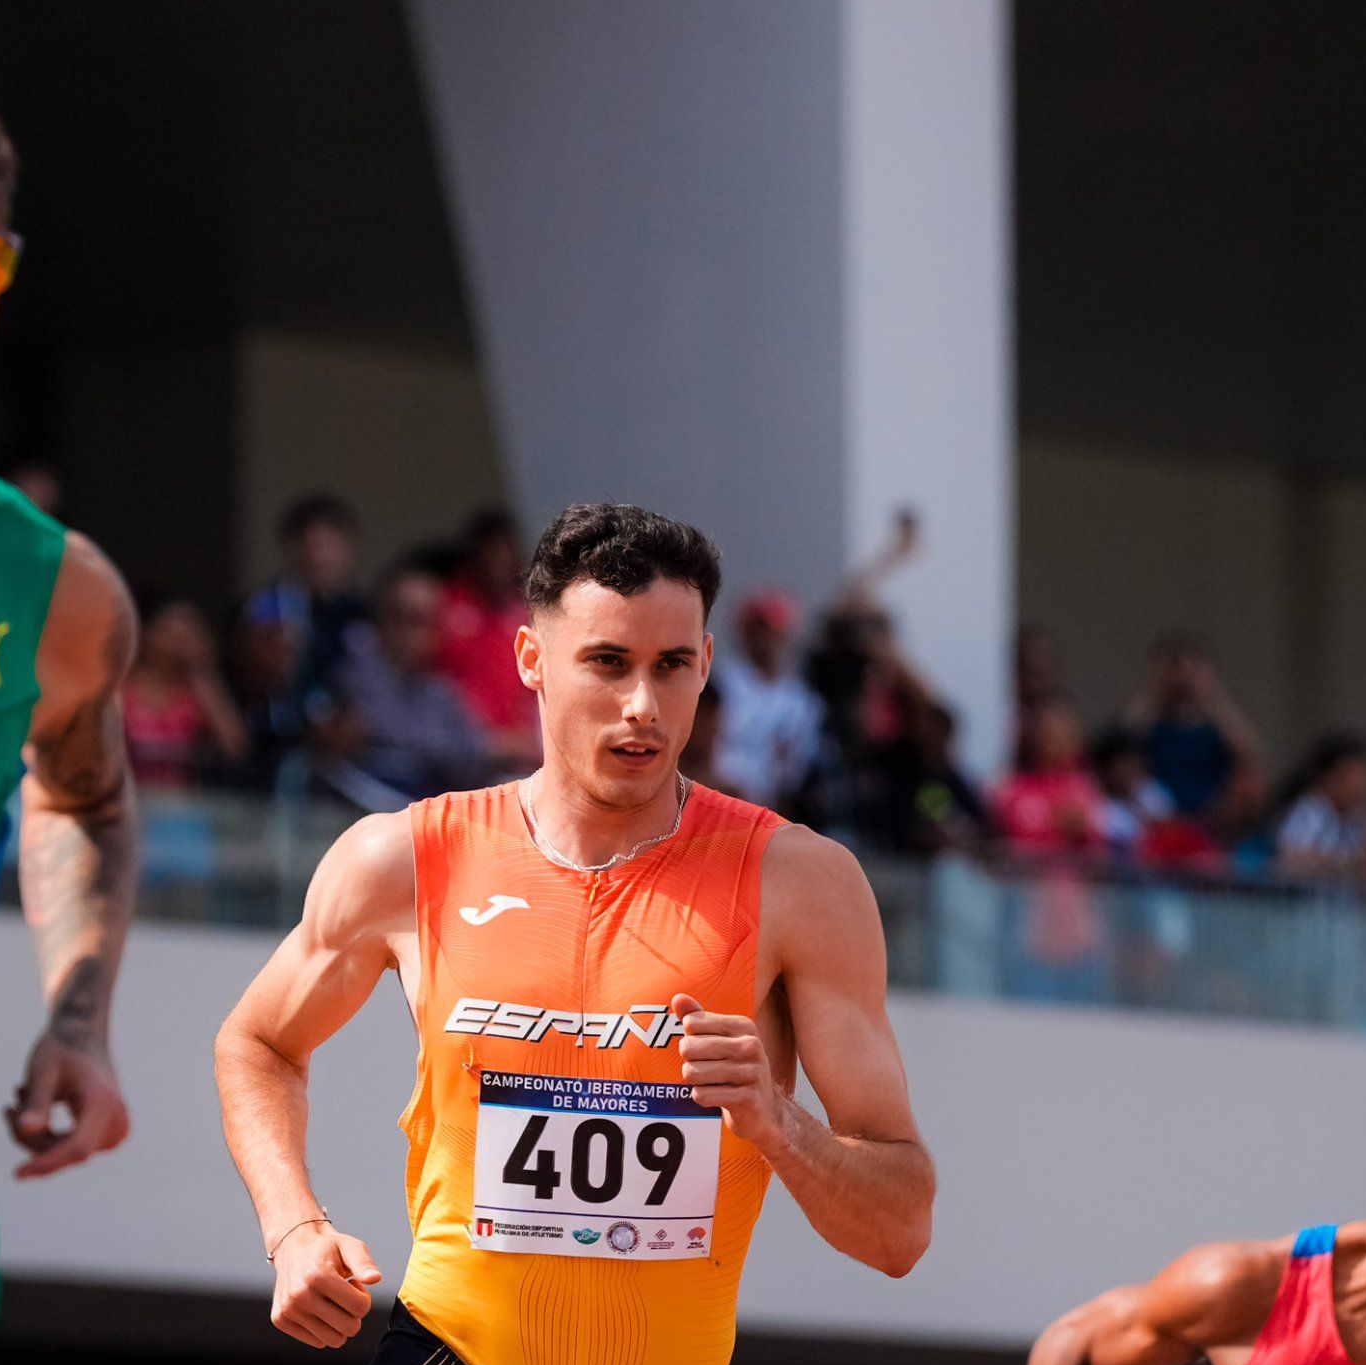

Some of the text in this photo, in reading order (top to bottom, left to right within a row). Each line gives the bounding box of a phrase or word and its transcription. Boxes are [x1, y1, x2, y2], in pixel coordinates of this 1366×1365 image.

[482, 1073, 583, 1094] CAMPEONATO
[552, 1095, 649, 1114] DE MAYORES
[502, 1114, 687, 1206] 409
